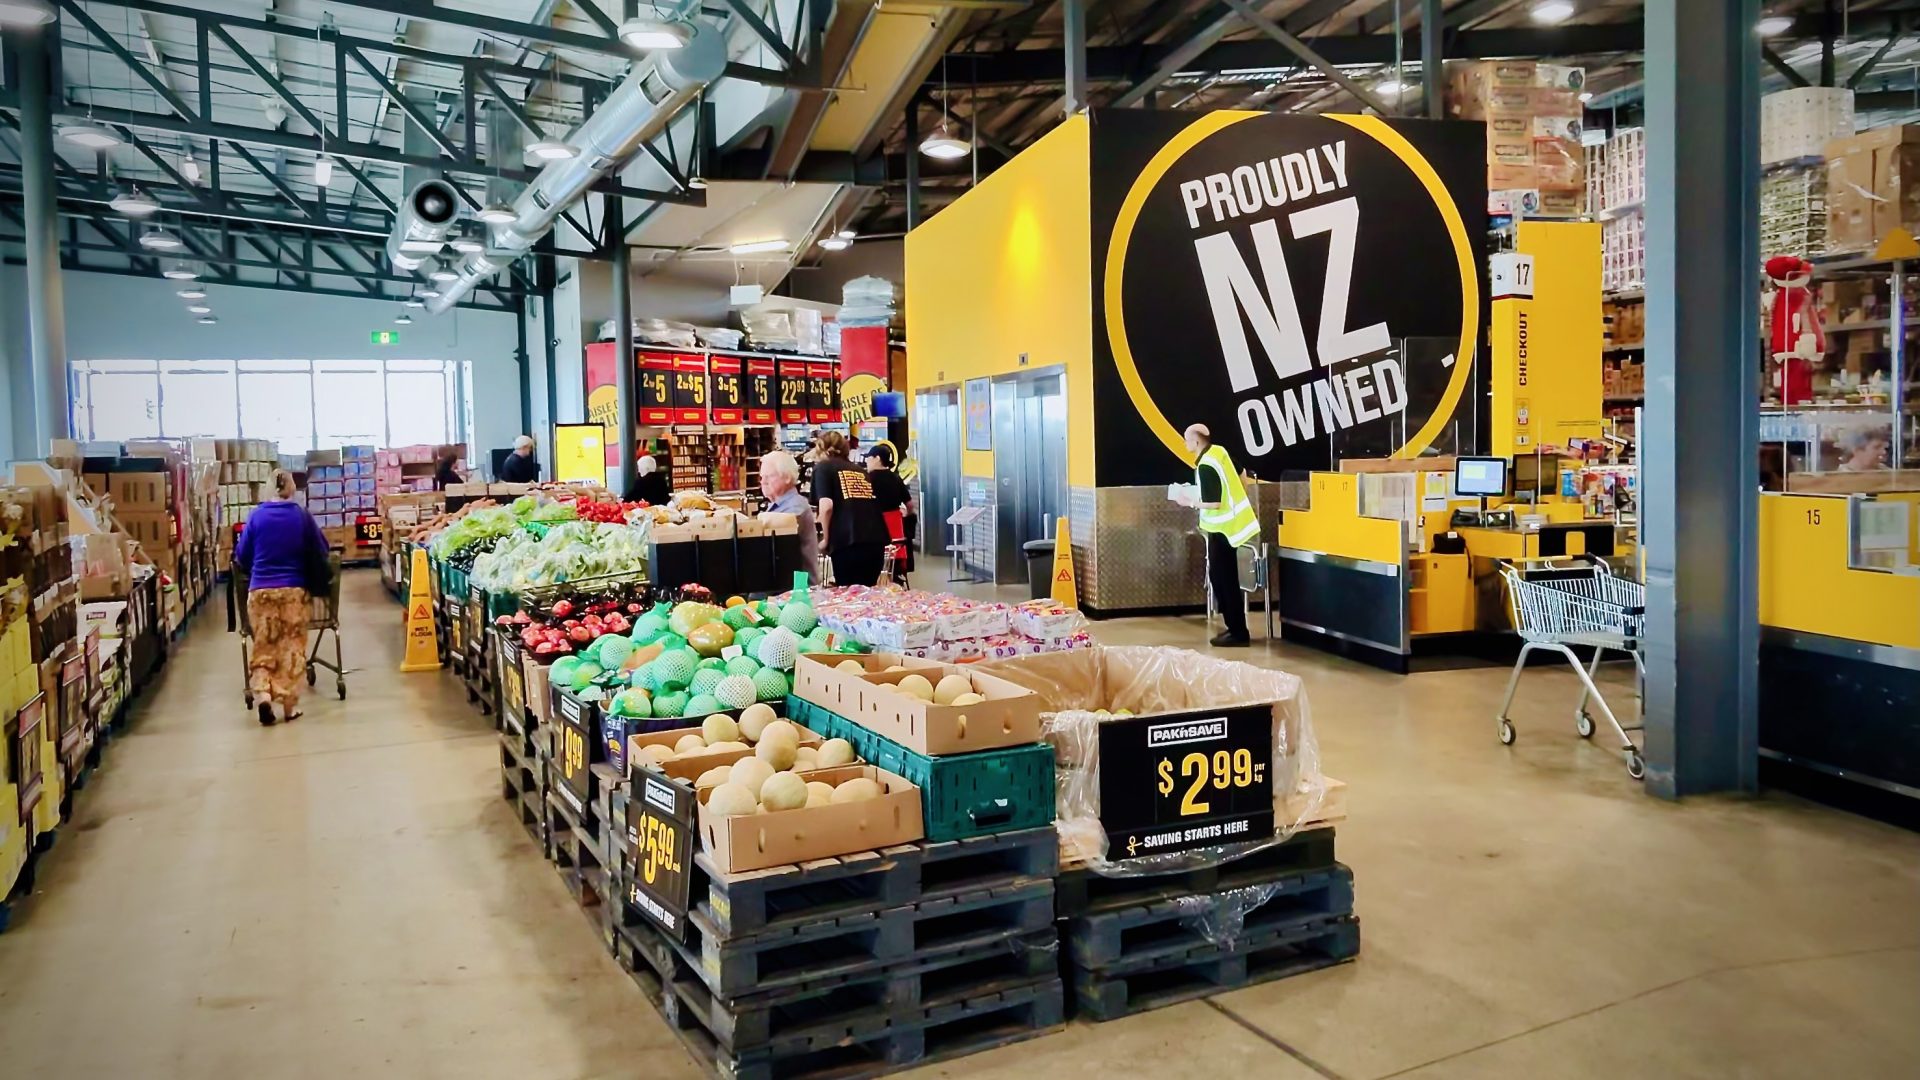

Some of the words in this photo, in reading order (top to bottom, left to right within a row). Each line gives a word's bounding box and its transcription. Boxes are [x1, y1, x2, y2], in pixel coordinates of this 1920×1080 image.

[1180, 140, 1349, 228] PROUDLY
[1516, 263, 1531, 286] 17
[1194, 196, 1392, 393] NZ
[1518, 311, 1528, 387] CHECKOUT
[655, 374, 666, 403] 5
[677, 374, 683, 390] 2
[729, 378, 739, 405] 5
[842, 392, 868, 410] AISLE
[1237, 358, 1408, 457] OWNED
[1806, 509, 1821, 526] 15
[1254, 763, 1265, 772] per
[1254, 773, 1263, 783] kg
[1144, 832, 1182, 849] SAVING
[1184, 825, 1221, 842] STARTS
[1223, 820, 1249, 835] HERE
